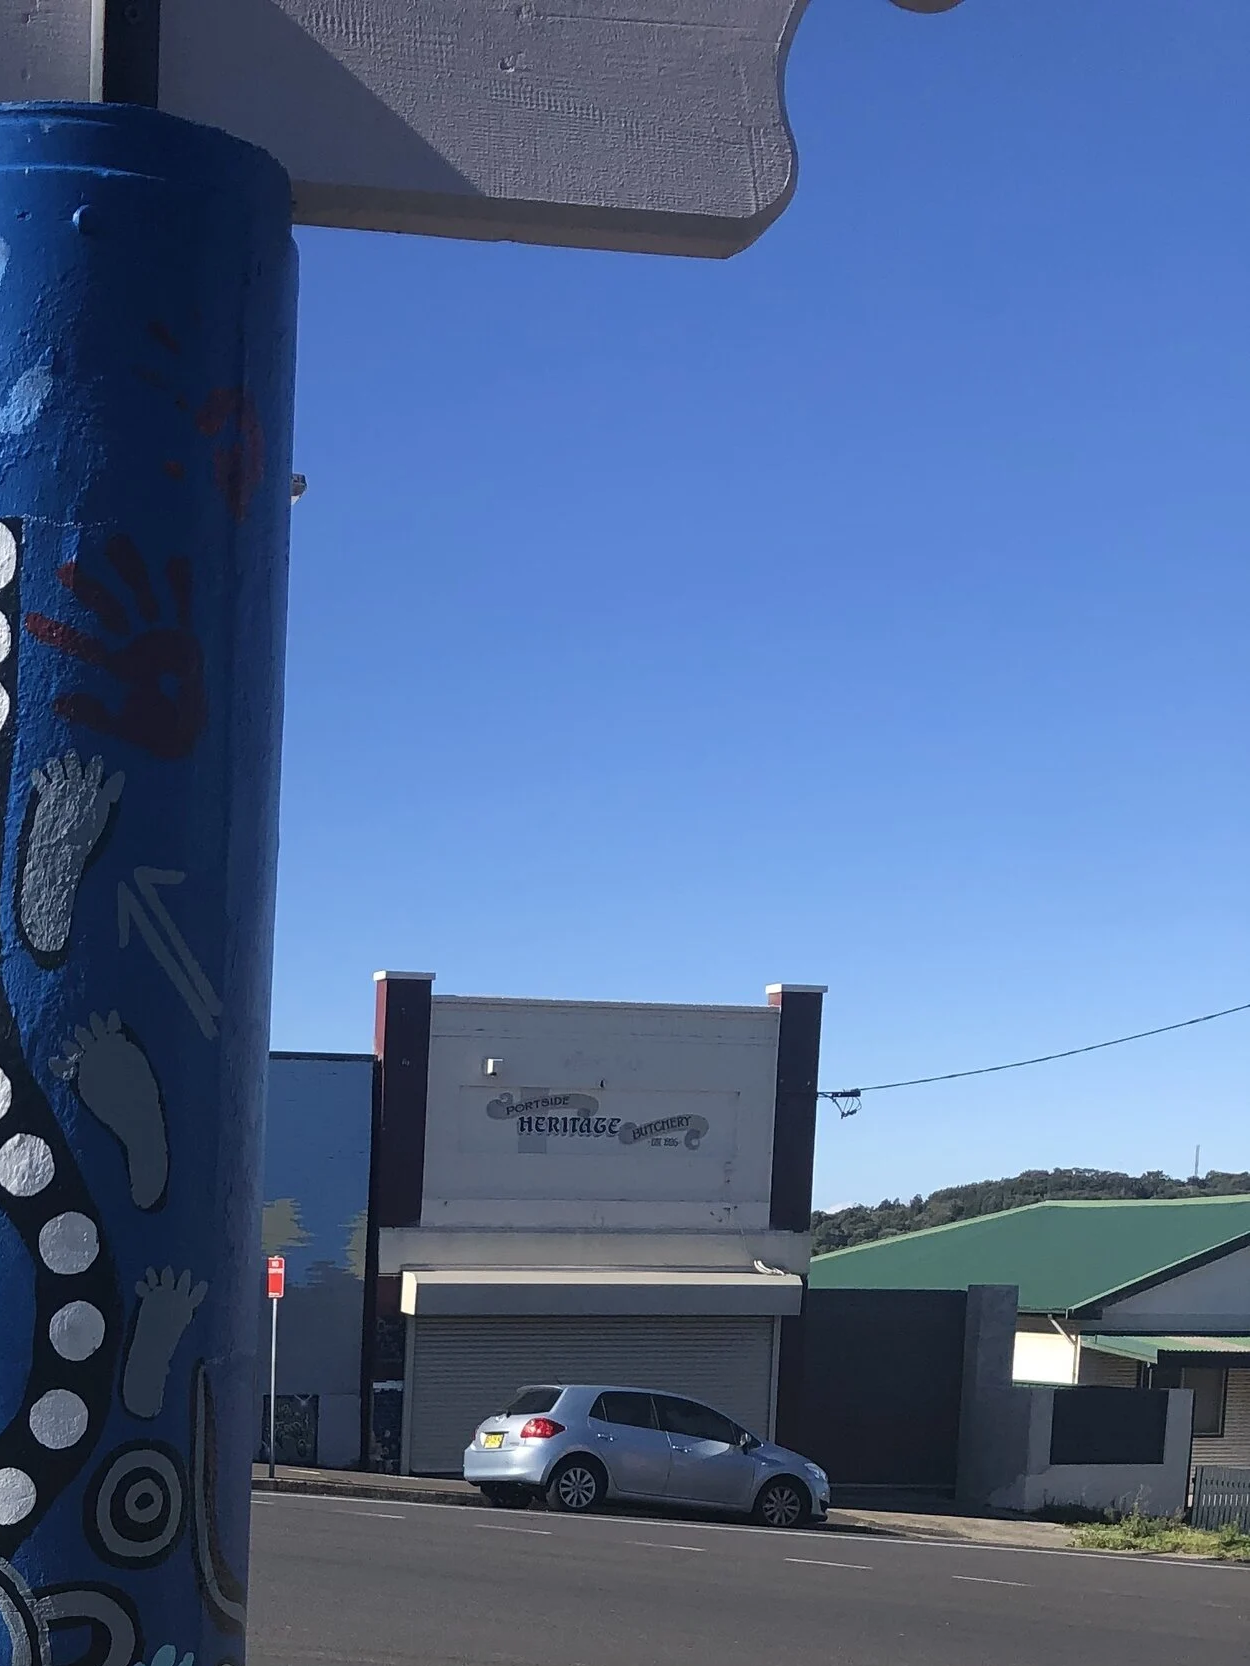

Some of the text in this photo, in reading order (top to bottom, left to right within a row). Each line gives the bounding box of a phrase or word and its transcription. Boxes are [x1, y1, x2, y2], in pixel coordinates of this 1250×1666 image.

[506, 1095, 570, 1116] PORTSIDE
[518, 1116, 622, 1136] HERITAGE
[632, 1115, 693, 1141] BUTCHERY
